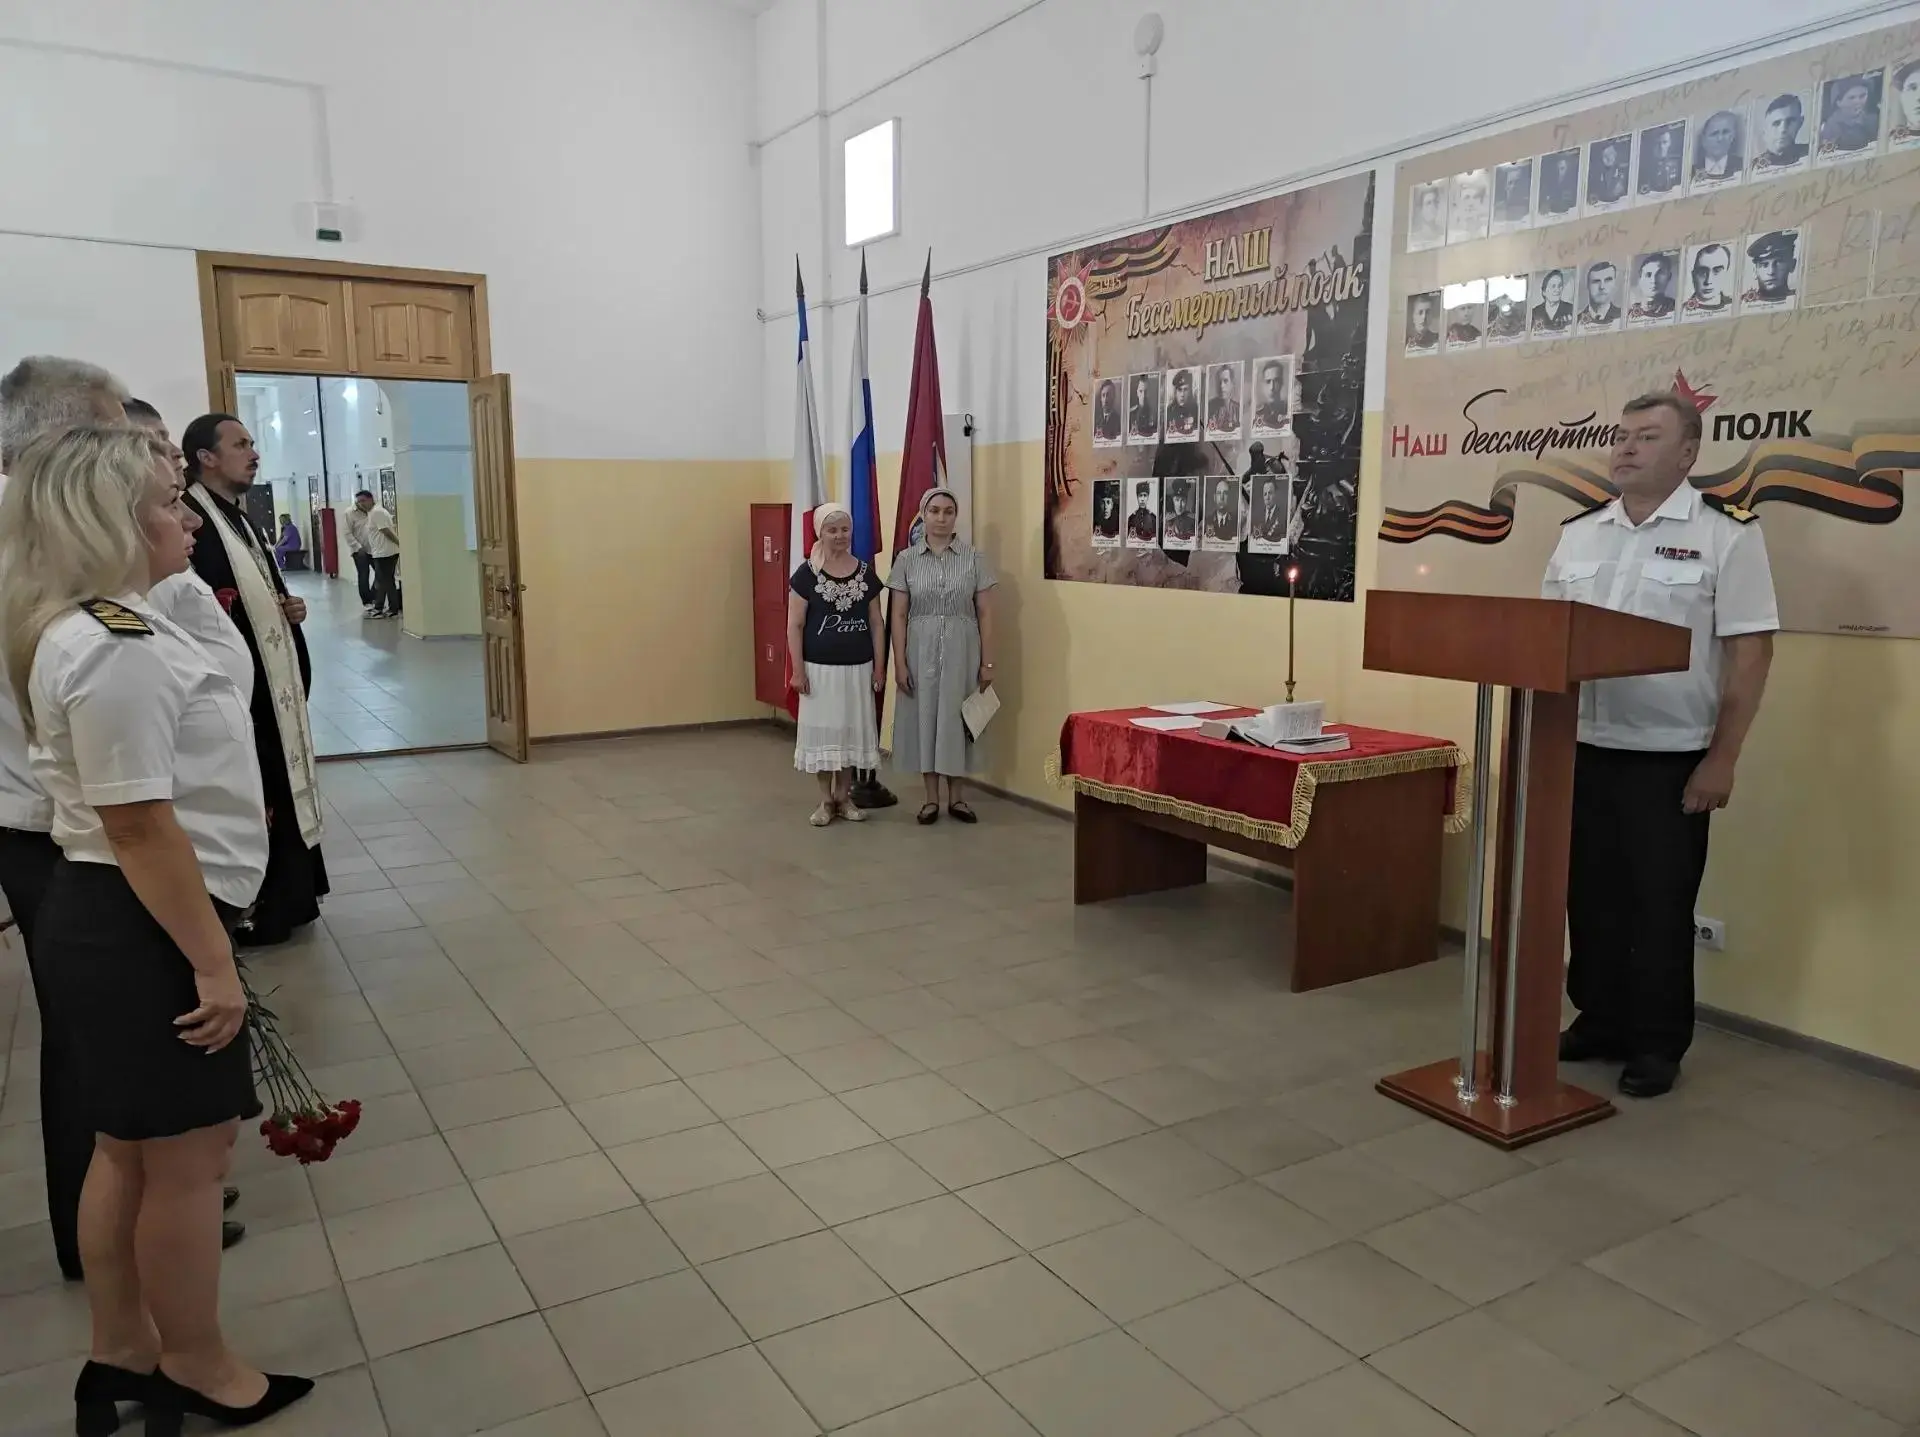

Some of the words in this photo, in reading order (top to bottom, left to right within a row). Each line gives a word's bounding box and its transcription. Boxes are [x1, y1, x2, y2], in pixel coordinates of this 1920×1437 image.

[1204, 227, 1273, 281] НАШ
[1126, 264, 1289, 341] Бессмертный
[1291, 263, 1364, 310] полк
[1461, 388, 1620, 461] бессмертны
[1712, 409, 1813, 442] ПОЛК
[817, 614, 868, 636] Paris
